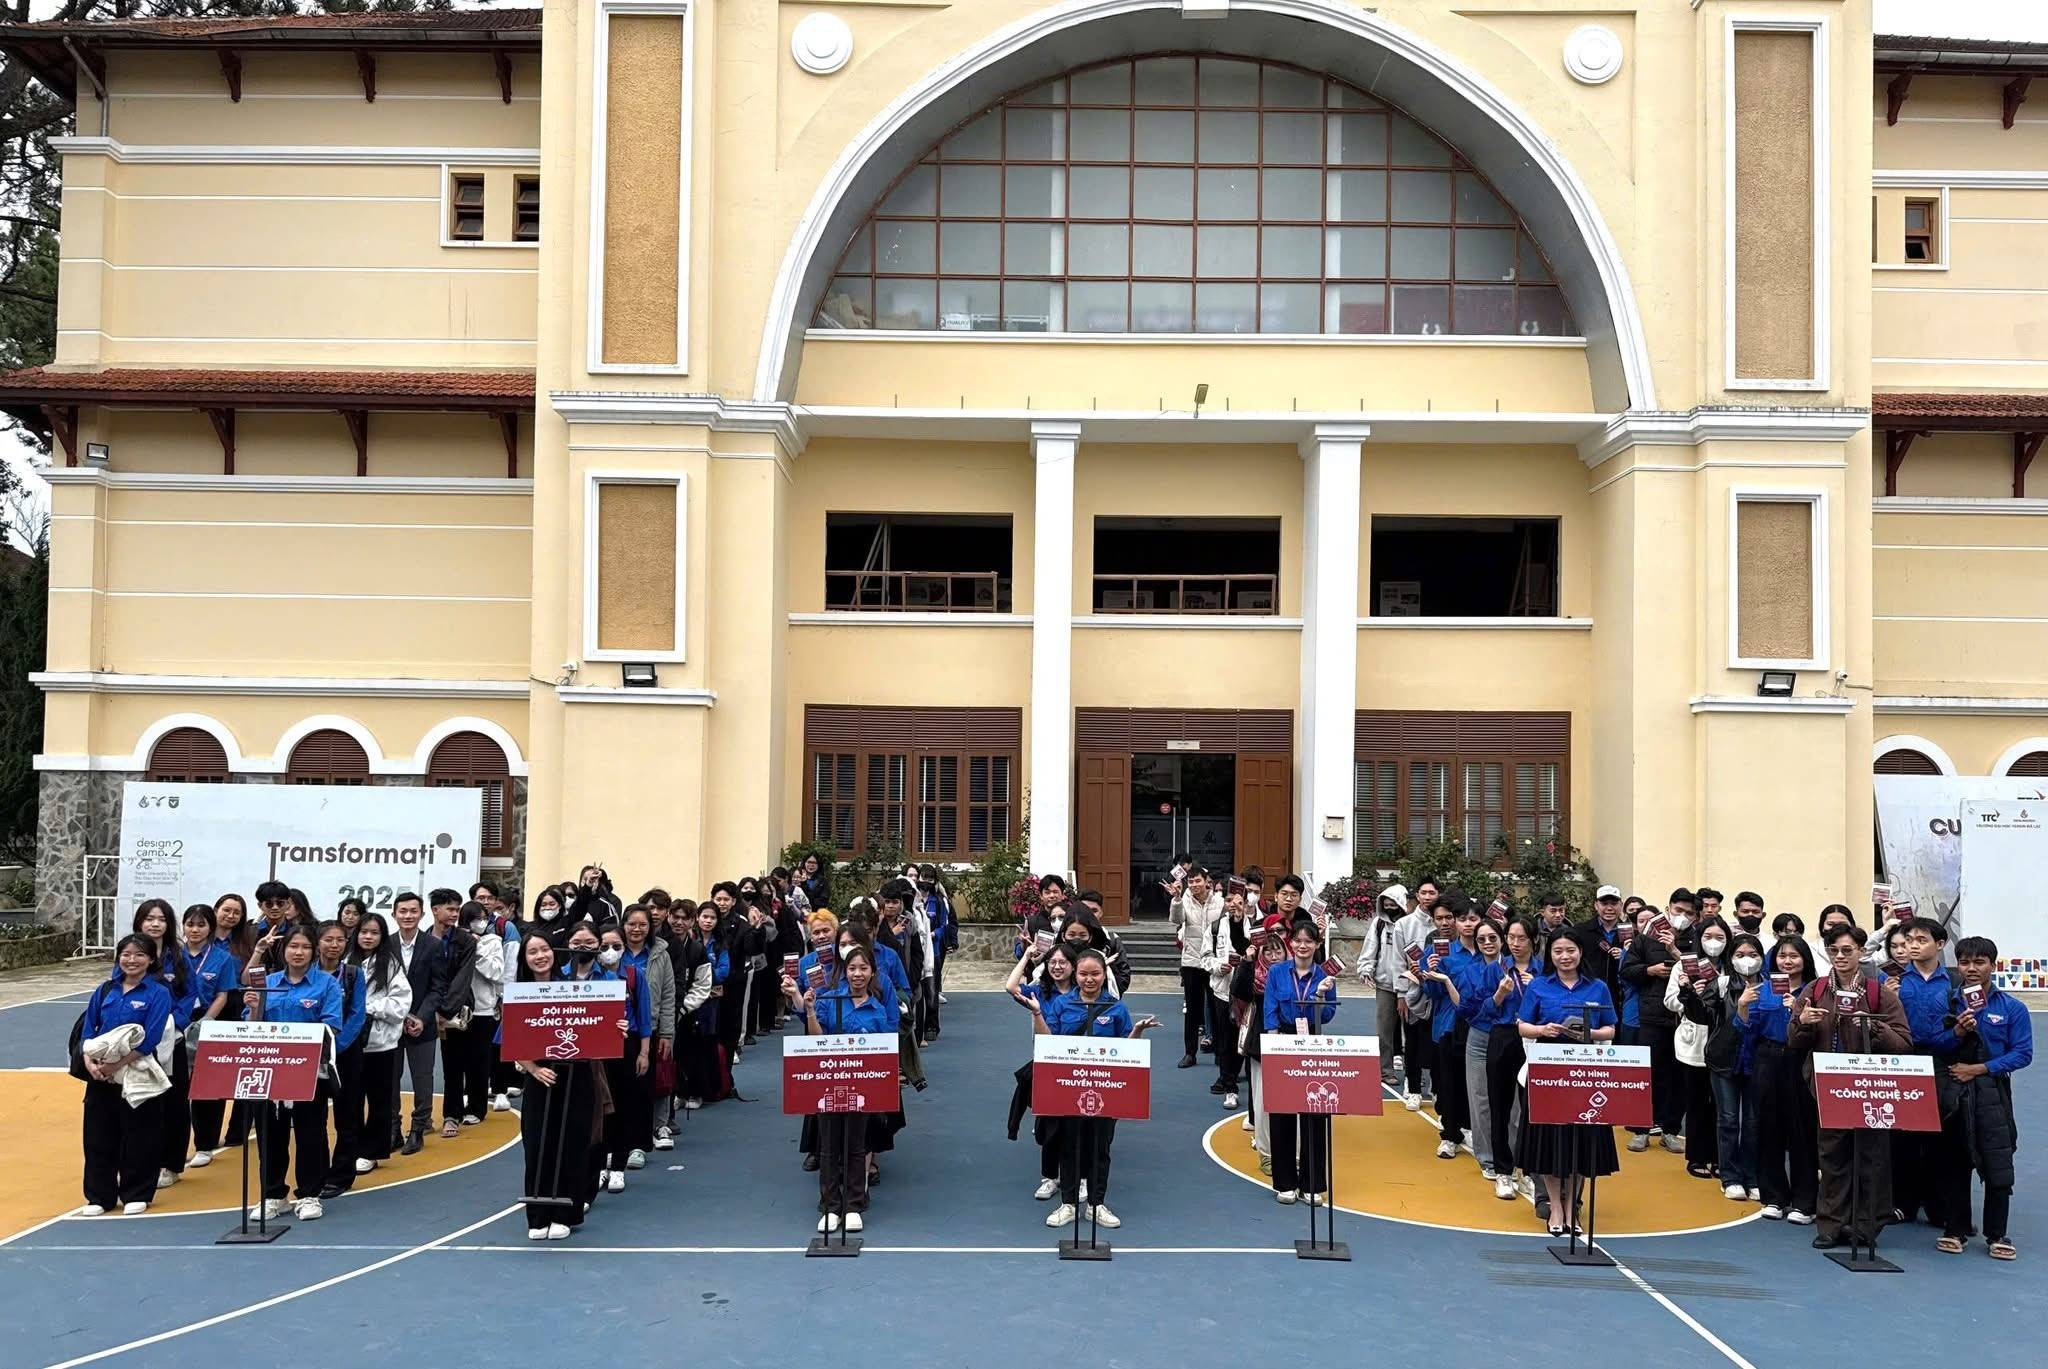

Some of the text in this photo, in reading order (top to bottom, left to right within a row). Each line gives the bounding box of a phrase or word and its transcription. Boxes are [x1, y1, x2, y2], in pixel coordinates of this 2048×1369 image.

[136, 838, 172, 850] design
[171, 840, 184, 857] 2
[543, 1006, 586, 1016] ĐỘI HÌNH
[240, 1047, 255, 1055] ĐỘI
[235, 1057, 252, 1065] TẠO
[260, 1056, 282, 1064] SÁNG
[820, 1059, 863, 1069] ĐỘI HÌNH
[1302, 1059, 1317, 1068] ĐỘI
[816, 1071, 832, 1079] SỨC
[834, 1070, 850, 1079] ĐẾN
[1073, 1069, 1110, 1078] ĐỘI HÌNH
[1570, 1069, 1585, 1078] ĐỘI
[1596, 1080, 1619, 1088] CÔNG
[1855, 1078, 1896, 1088] ĐỘI HÌNH
[1870, 1089, 1901, 1101] NGHỆ
